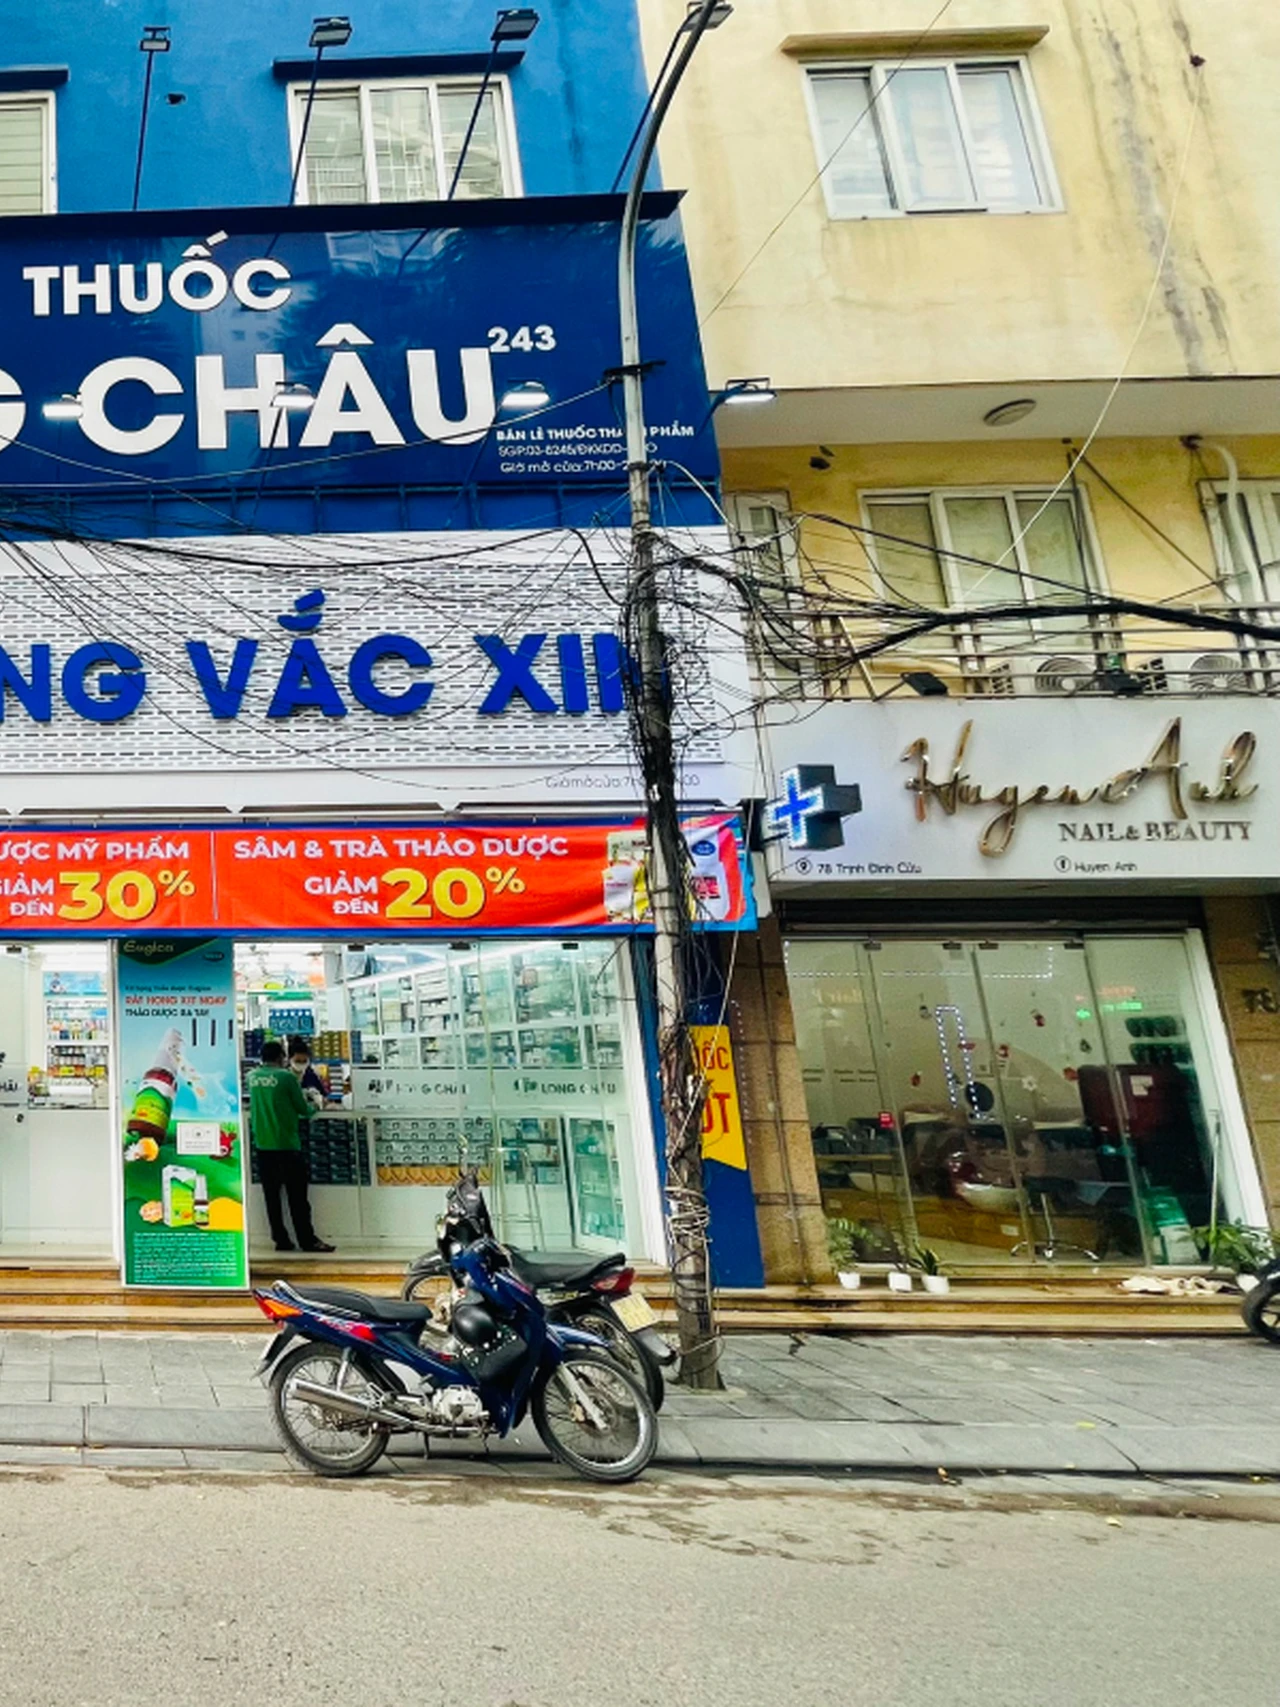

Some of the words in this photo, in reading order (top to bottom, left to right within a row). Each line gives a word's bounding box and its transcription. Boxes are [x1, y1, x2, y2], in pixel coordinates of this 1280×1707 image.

[23, 230, 292, 316] THUỐC
[487, 325, 555, 353] 243
[77, 323, 496, 456] CHÂU
[547, 424, 598, 440] THUỐC
[650, 419, 695, 437] PHẨM
[186, 588, 435, 720] VẮC
[1058, 823, 1124, 842] NAIL
[1145, 820, 1253, 842] BEAUTY
[57, 837, 99, 860] MỸ
[106, 835, 190, 860] PHẨM
[234, 832, 298, 859] SÂM
[304, 840, 324, 858] &
[330, 832, 385, 859] TRÀ
[392, 831, 475, 858] THẢO
[482, 836, 568, 862] DƯỢC
[817, 863, 832, 875] 78
[58, 869, 196, 922] 30%
[304, 869, 379, 896] GIẢM
[385, 866, 526, 920] 20%
[332, 897, 379, 915] ĐẾN
[9, 898, 55, 917] ĐẾN
[249, 1075, 279, 1088] Grab
